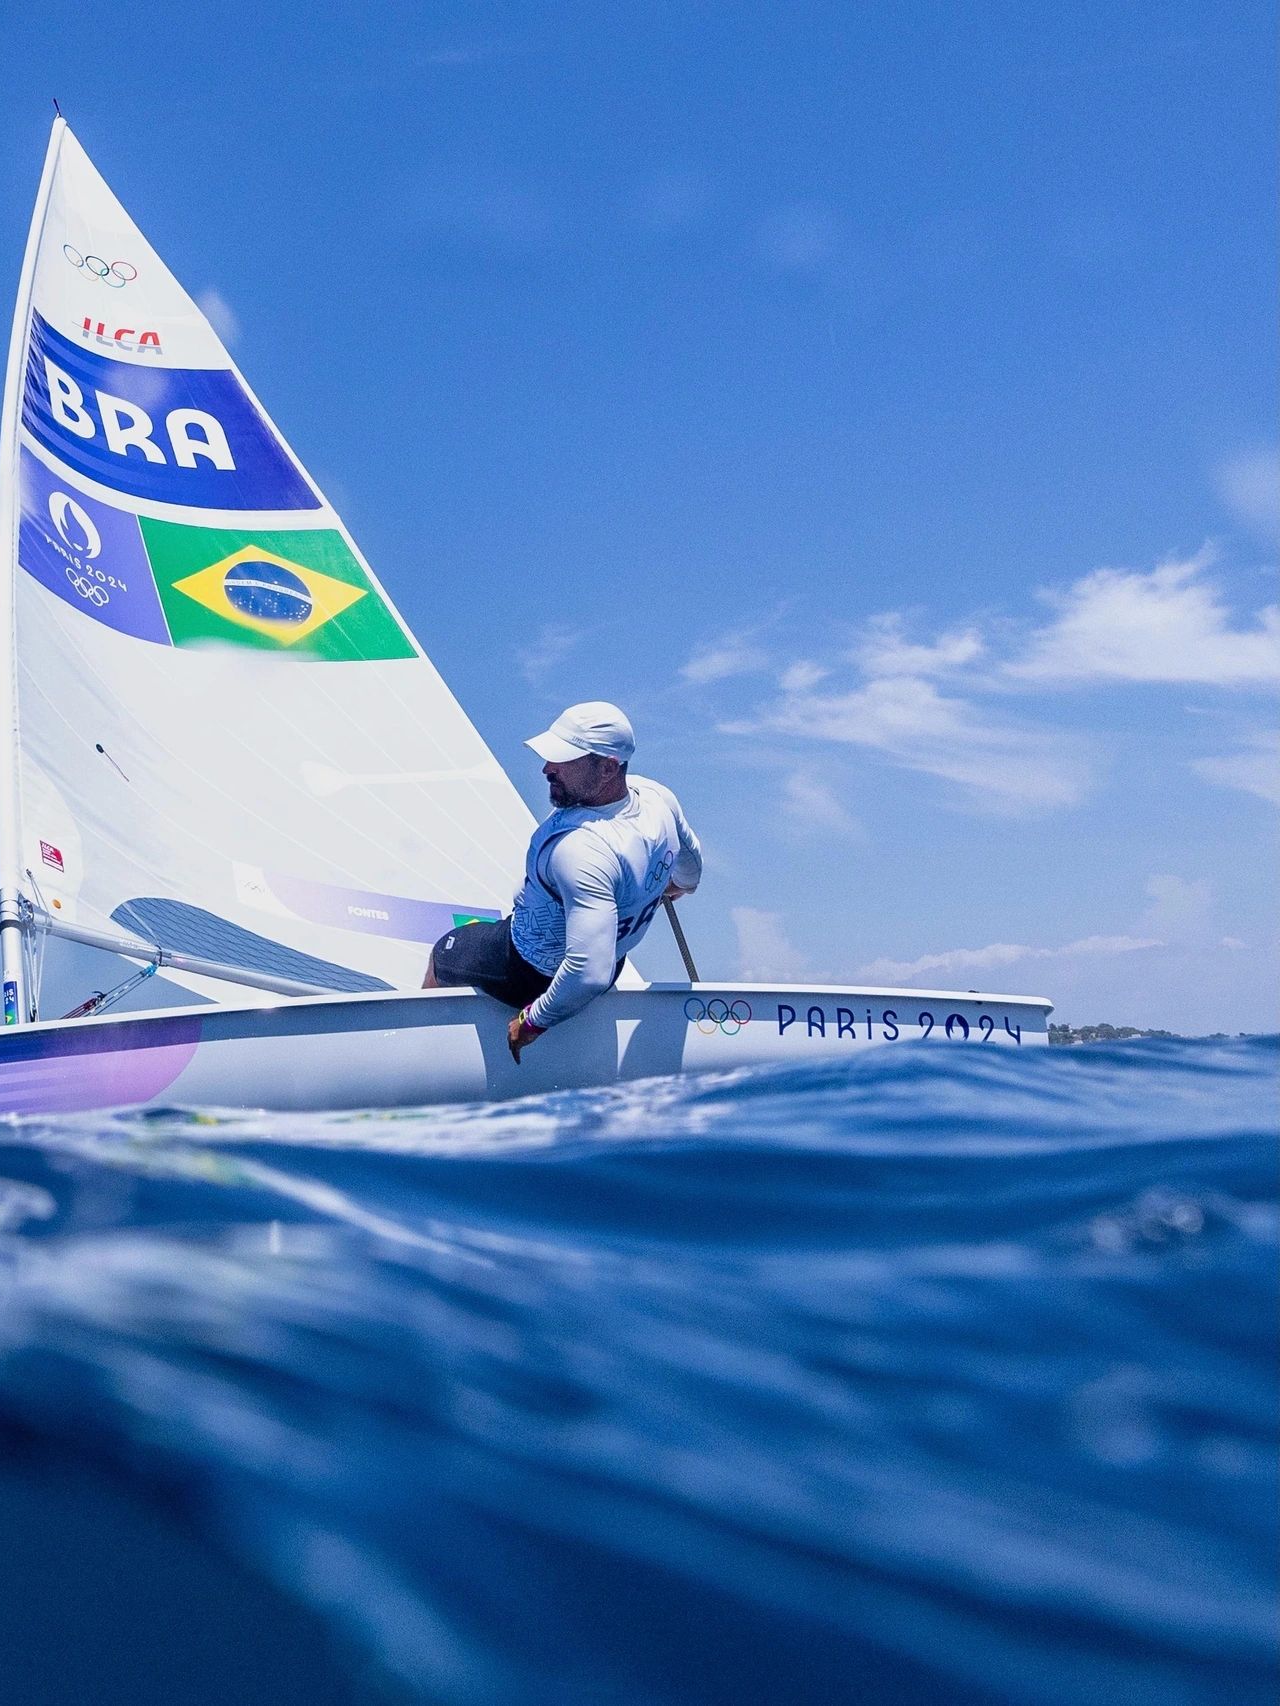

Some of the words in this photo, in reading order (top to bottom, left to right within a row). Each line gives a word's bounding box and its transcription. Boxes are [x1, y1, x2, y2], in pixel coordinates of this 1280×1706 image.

[82, 316, 163, 355] ILCA
[44, 355, 236, 470] BRA
[85, 564, 127, 592] 2024
[347, 905, 389, 921] FONTES
[918, 1011, 1021, 1045] 2024
